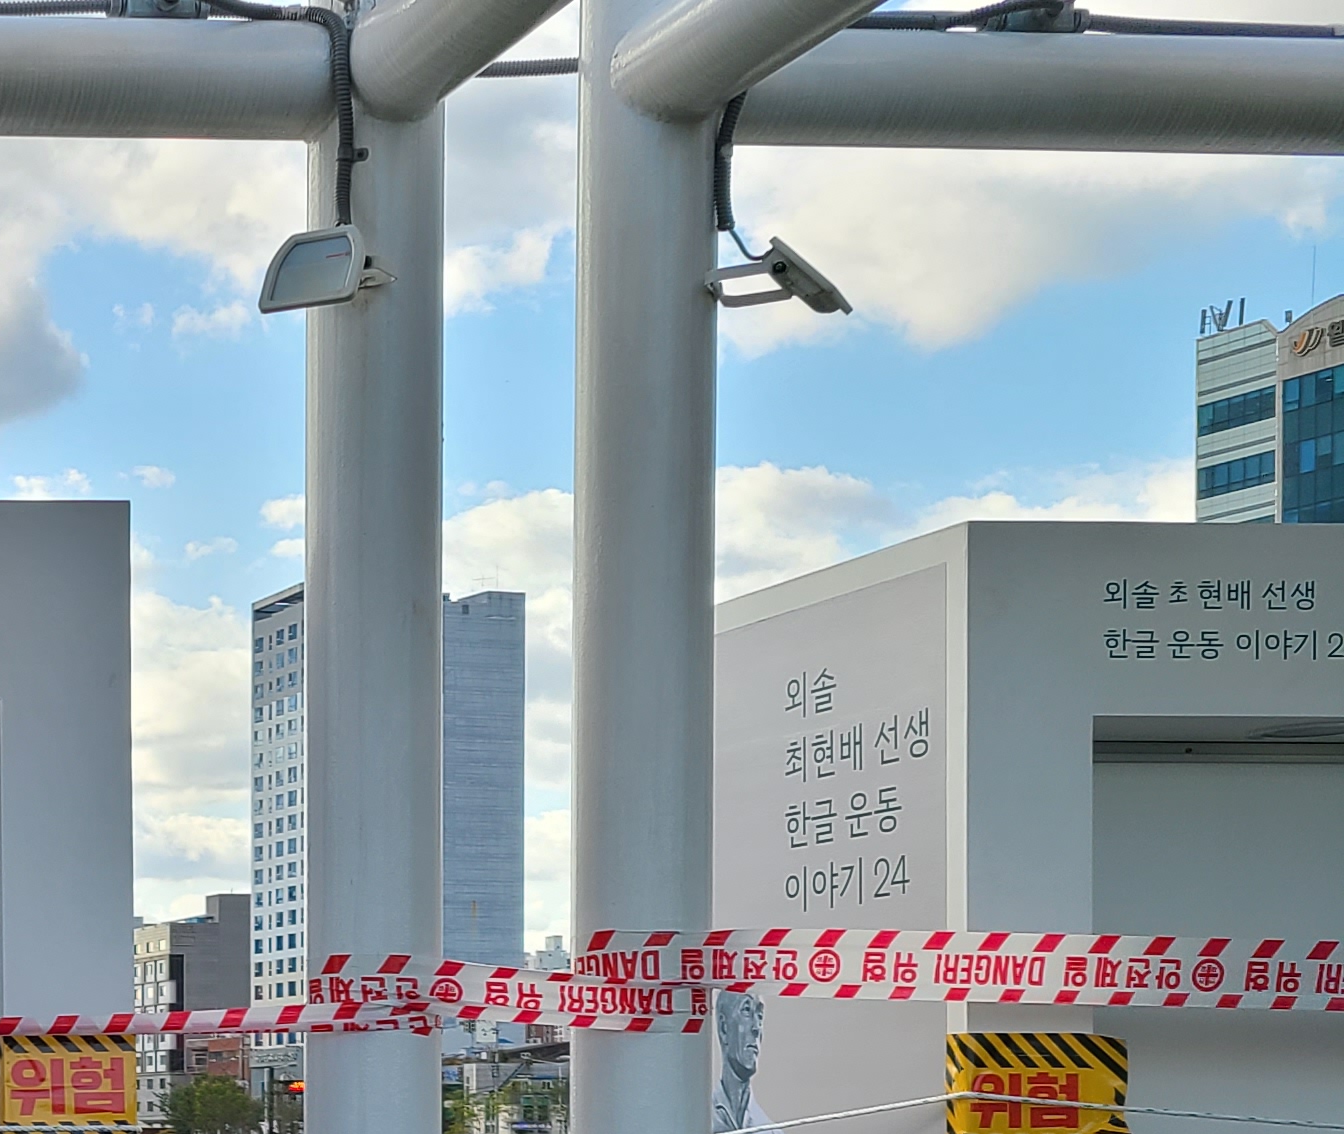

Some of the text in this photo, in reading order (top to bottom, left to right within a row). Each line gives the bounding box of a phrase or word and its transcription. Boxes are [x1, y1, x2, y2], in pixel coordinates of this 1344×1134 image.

[1104, 579, 1160, 610] 외솔
[1261, 579, 1317, 611] 선생
[1103, 628, 1160, 660] 한글
[1166, 628, 1225, 661] 운동
[1235, 628, 1318, 661] 이야기
[784, 667, 837, 718] 외솔
[784, 707, 931, 783] 최현배 선생
[784, 786, 903, 849] 한글 운동
[784, 855, 911, 912] 이야기 24
[681, 948, 798, 981] 안전제일
[861, 951, 919, 984] 위험
[934, 953, 1045, 986] DANGER!
[1063, 956, 1181, 990] 안전제일
[1244, 960, 1303, 993] 위험
[559, 984, 673, 1016] DANGER!
[9, 1056, 126, 1117] 위험
[969, 1071, 1081, 1129] 위험
